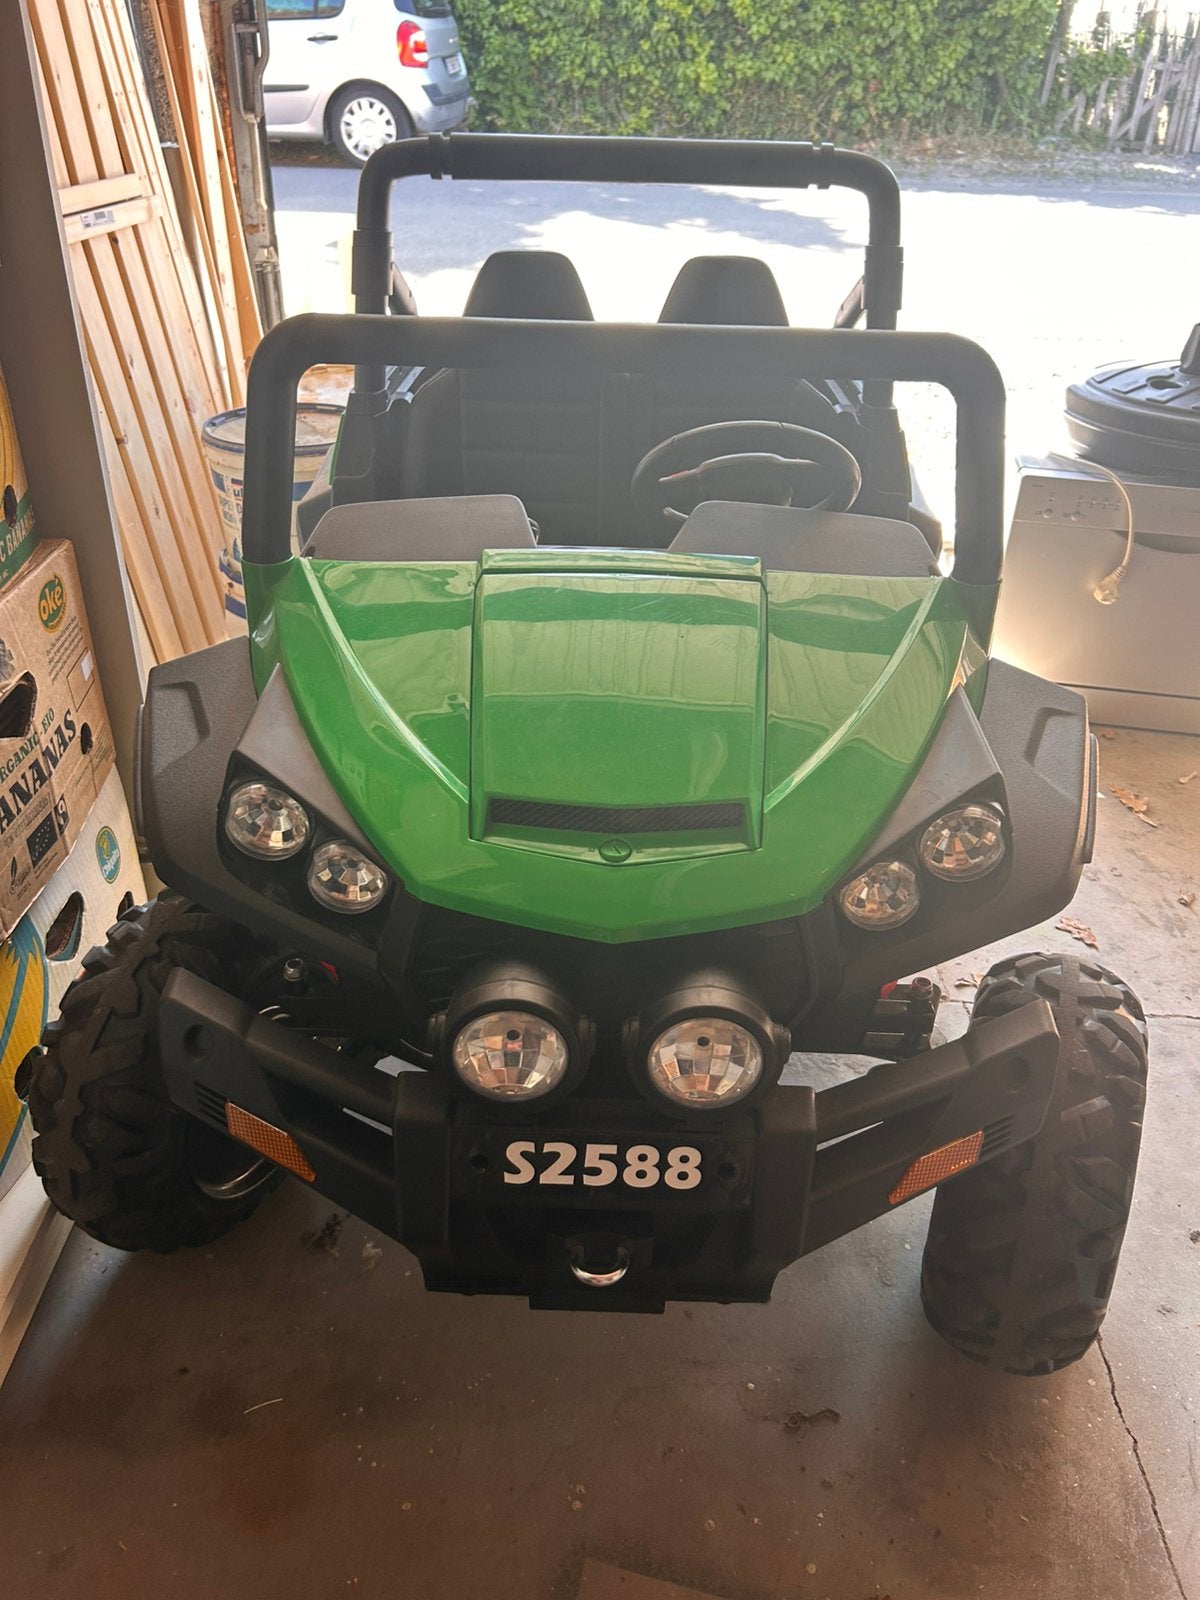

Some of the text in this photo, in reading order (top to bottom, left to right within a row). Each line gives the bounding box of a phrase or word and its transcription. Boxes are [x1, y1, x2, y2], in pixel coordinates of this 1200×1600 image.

[0, 731, 39, 784] RGANIC
[0, 708, 77, 835] ANANAS
[503, 1141, 702, 1190] S2588
